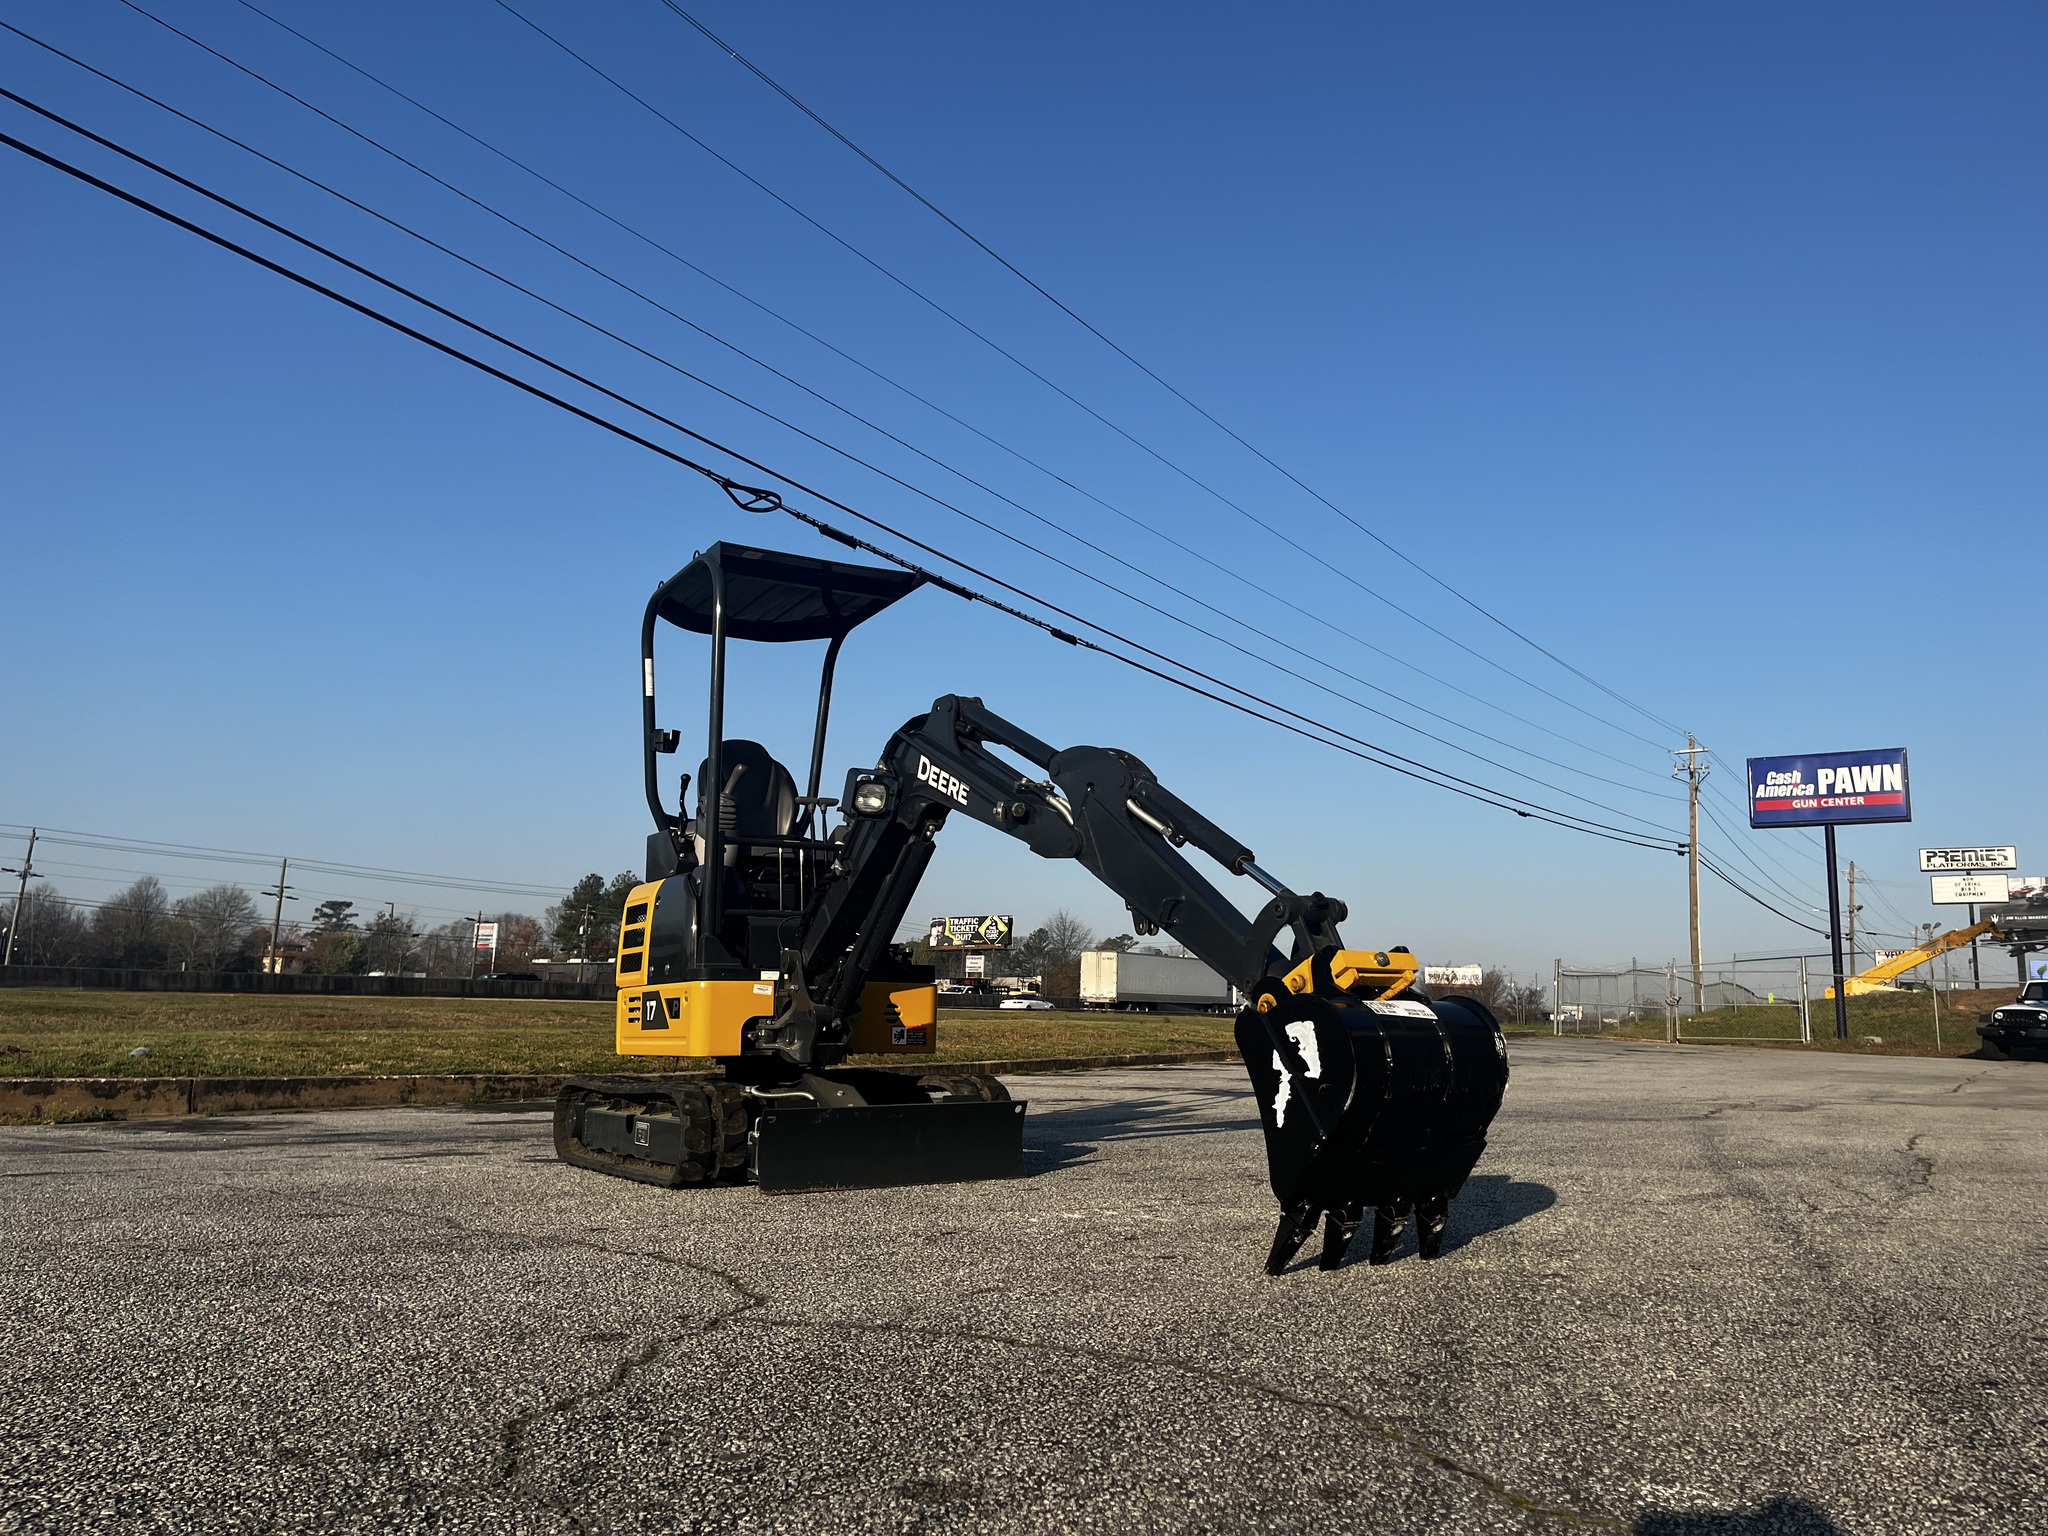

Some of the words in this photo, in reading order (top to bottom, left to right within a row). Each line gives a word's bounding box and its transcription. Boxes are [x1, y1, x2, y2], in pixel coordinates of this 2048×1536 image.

[917, 754, 970, 806] DEERE
[1766, 770, 1801, 785] Cash
[1817, 763, 1903, 795] PAWN
[1756, 783, 1814, 798] America
[1792, 799, 1817, 809] GUN
[1820, 796, 1865, 807] CENTER
[1926, 849, 2008, 863] PREMIER
[950, 917, 979, 925] TRAFFIC
[646, 1000, 657, 1021] 17
[672, 1000, 679, 1017] P
